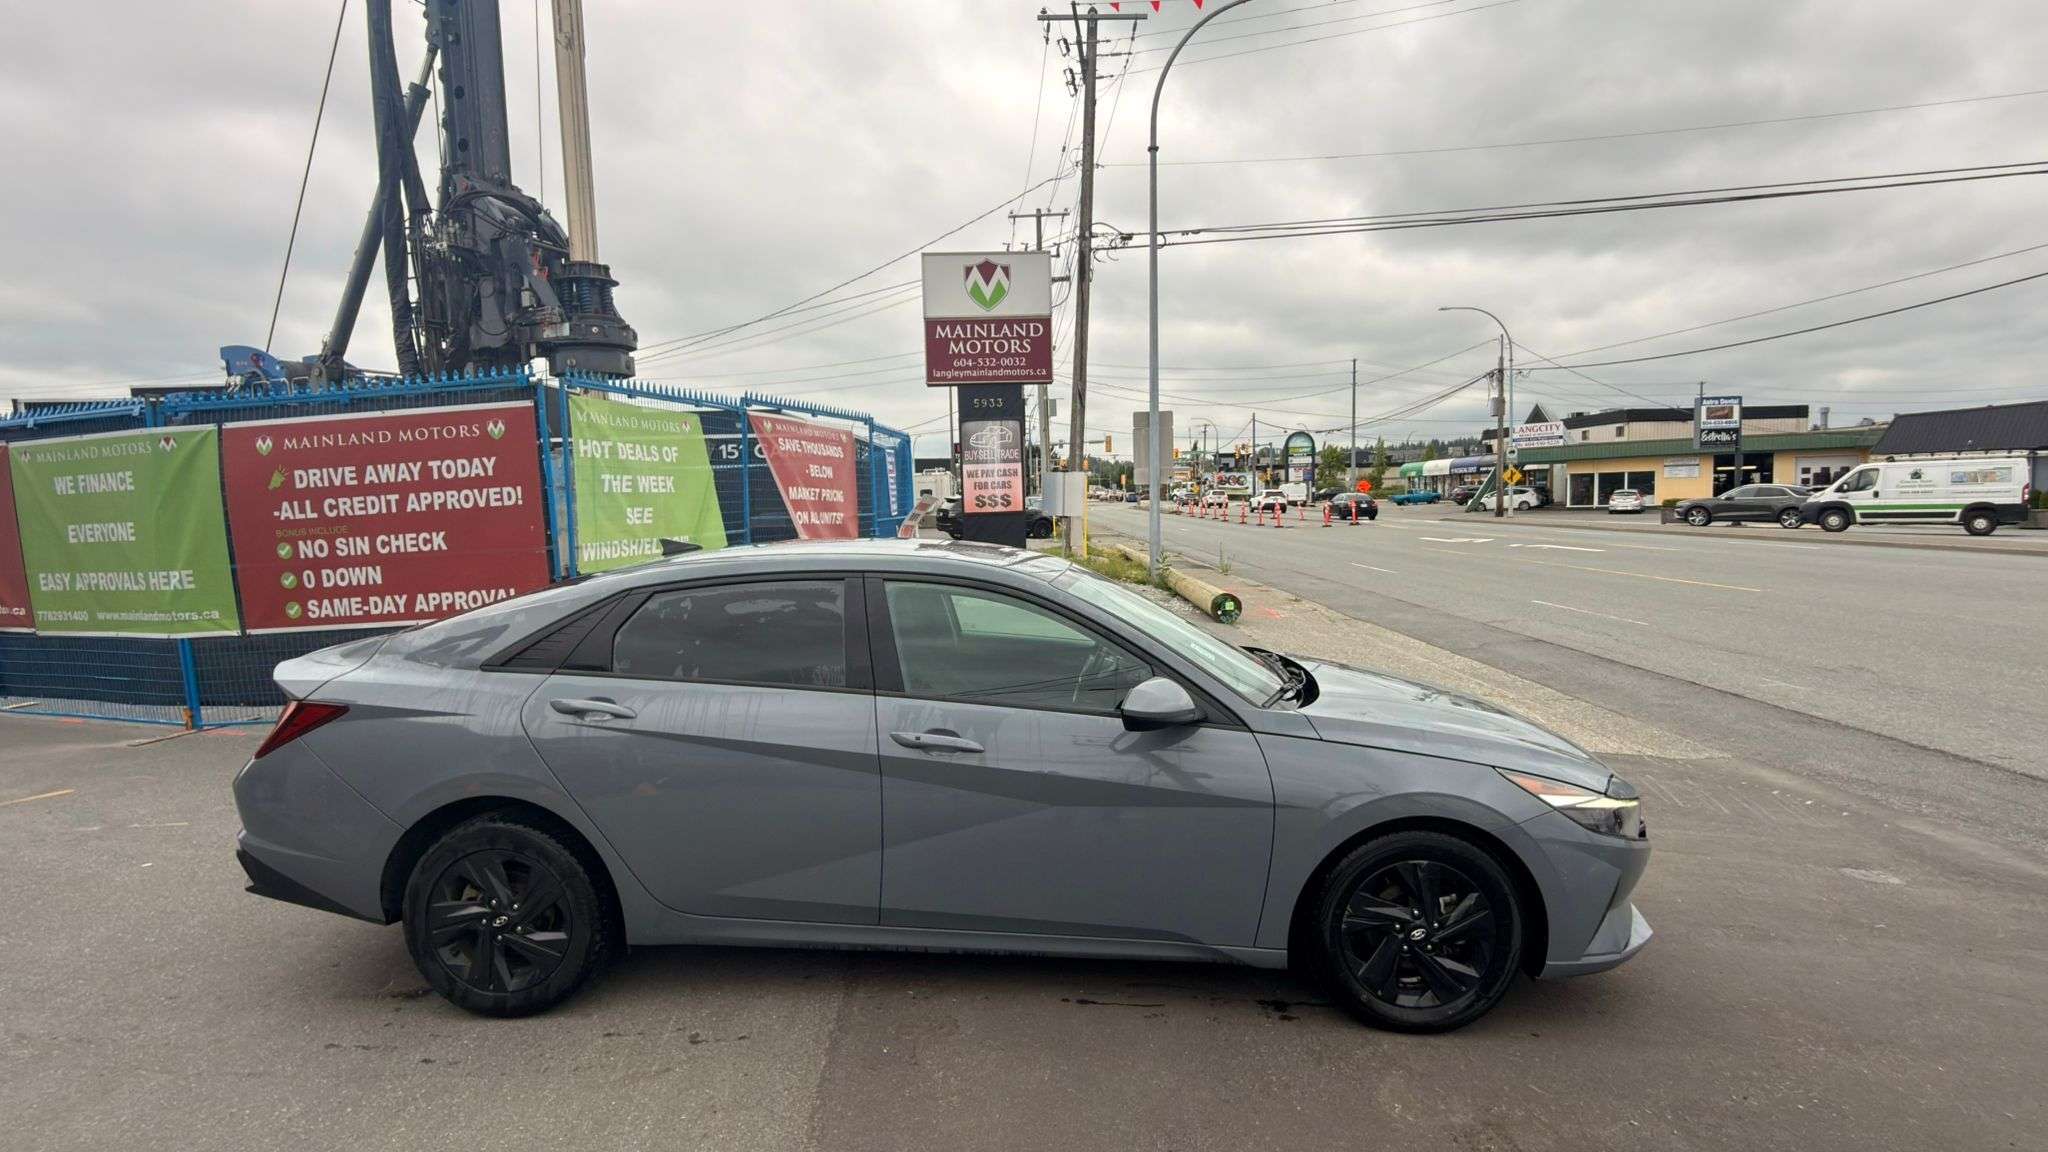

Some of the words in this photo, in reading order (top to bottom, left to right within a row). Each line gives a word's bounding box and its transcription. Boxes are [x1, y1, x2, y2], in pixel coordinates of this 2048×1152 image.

[936, 323, 1044, 339] MAINLAND
[949, 339, 1031, 354] MOTORS
[953, 357, 1026, 367] 604-532-0032
[933, 368, 1047, 378] langleymainlandmotors.ca
[973, 398, 1004, 408] 5933
[641, 419, 681, 433] MOTORS
[283, 431, 392, 450] MAINLAND
[398, 424, 480, 443] MOTORS
[36, 447, 97, 463] MAINLAND
[102, 440, 151, 456] MOTORS
[579, 439, 612, 459] HOT
[617, 442, 659, 462] DEALS
[662, 446, 679, 463] OF
[778, 438, 802, 453] SAVE
[802, 441, 844, 459] THOUSANDS
[294, 466, 358, 489] DRIVE
[364, 461, 422, 485] AWAY
[428, 457, 497, 479] TODAY
[966, 470, 979, 478] WE
[981, 469, 995, 478] PAY
[997, 468, 1018, 477] CASH
[53, 475, 75, 495] WE
[78, 471, 135, 492] FINANCE
[601, 474, 633, 493] THE
[637, 475, 675, 493] WEEK
[974, 481, 989, 490] FOR
[991, 481, 1012, 490] CARS
[323, 494, 400, 518] CREDIT
[406, 486, 523, 512] APPROVED!
[788, 487, 820, 501] MARKET
[975, 494, 1012, 508] $$$
[626, 507, 654, 524] SEE
[797, 511, 809, 524] ON
[67, 522, 136, 543] EVERYONE
[298, 538, 329, 559] NO
[335, 536, 370, 556] SIN
[376, 531, 448, 554] CHECK
[38, 573, 71, 591] EASY
[75, 571, 146, 591] APPROVALS
[149, 570, 195, 590] HERE
[322, 566, 382, 588] DOWN
[96, 608, 220, 622] www.mainlandmotors.ca
[307, 594, 407, 618] SAME-DAY
